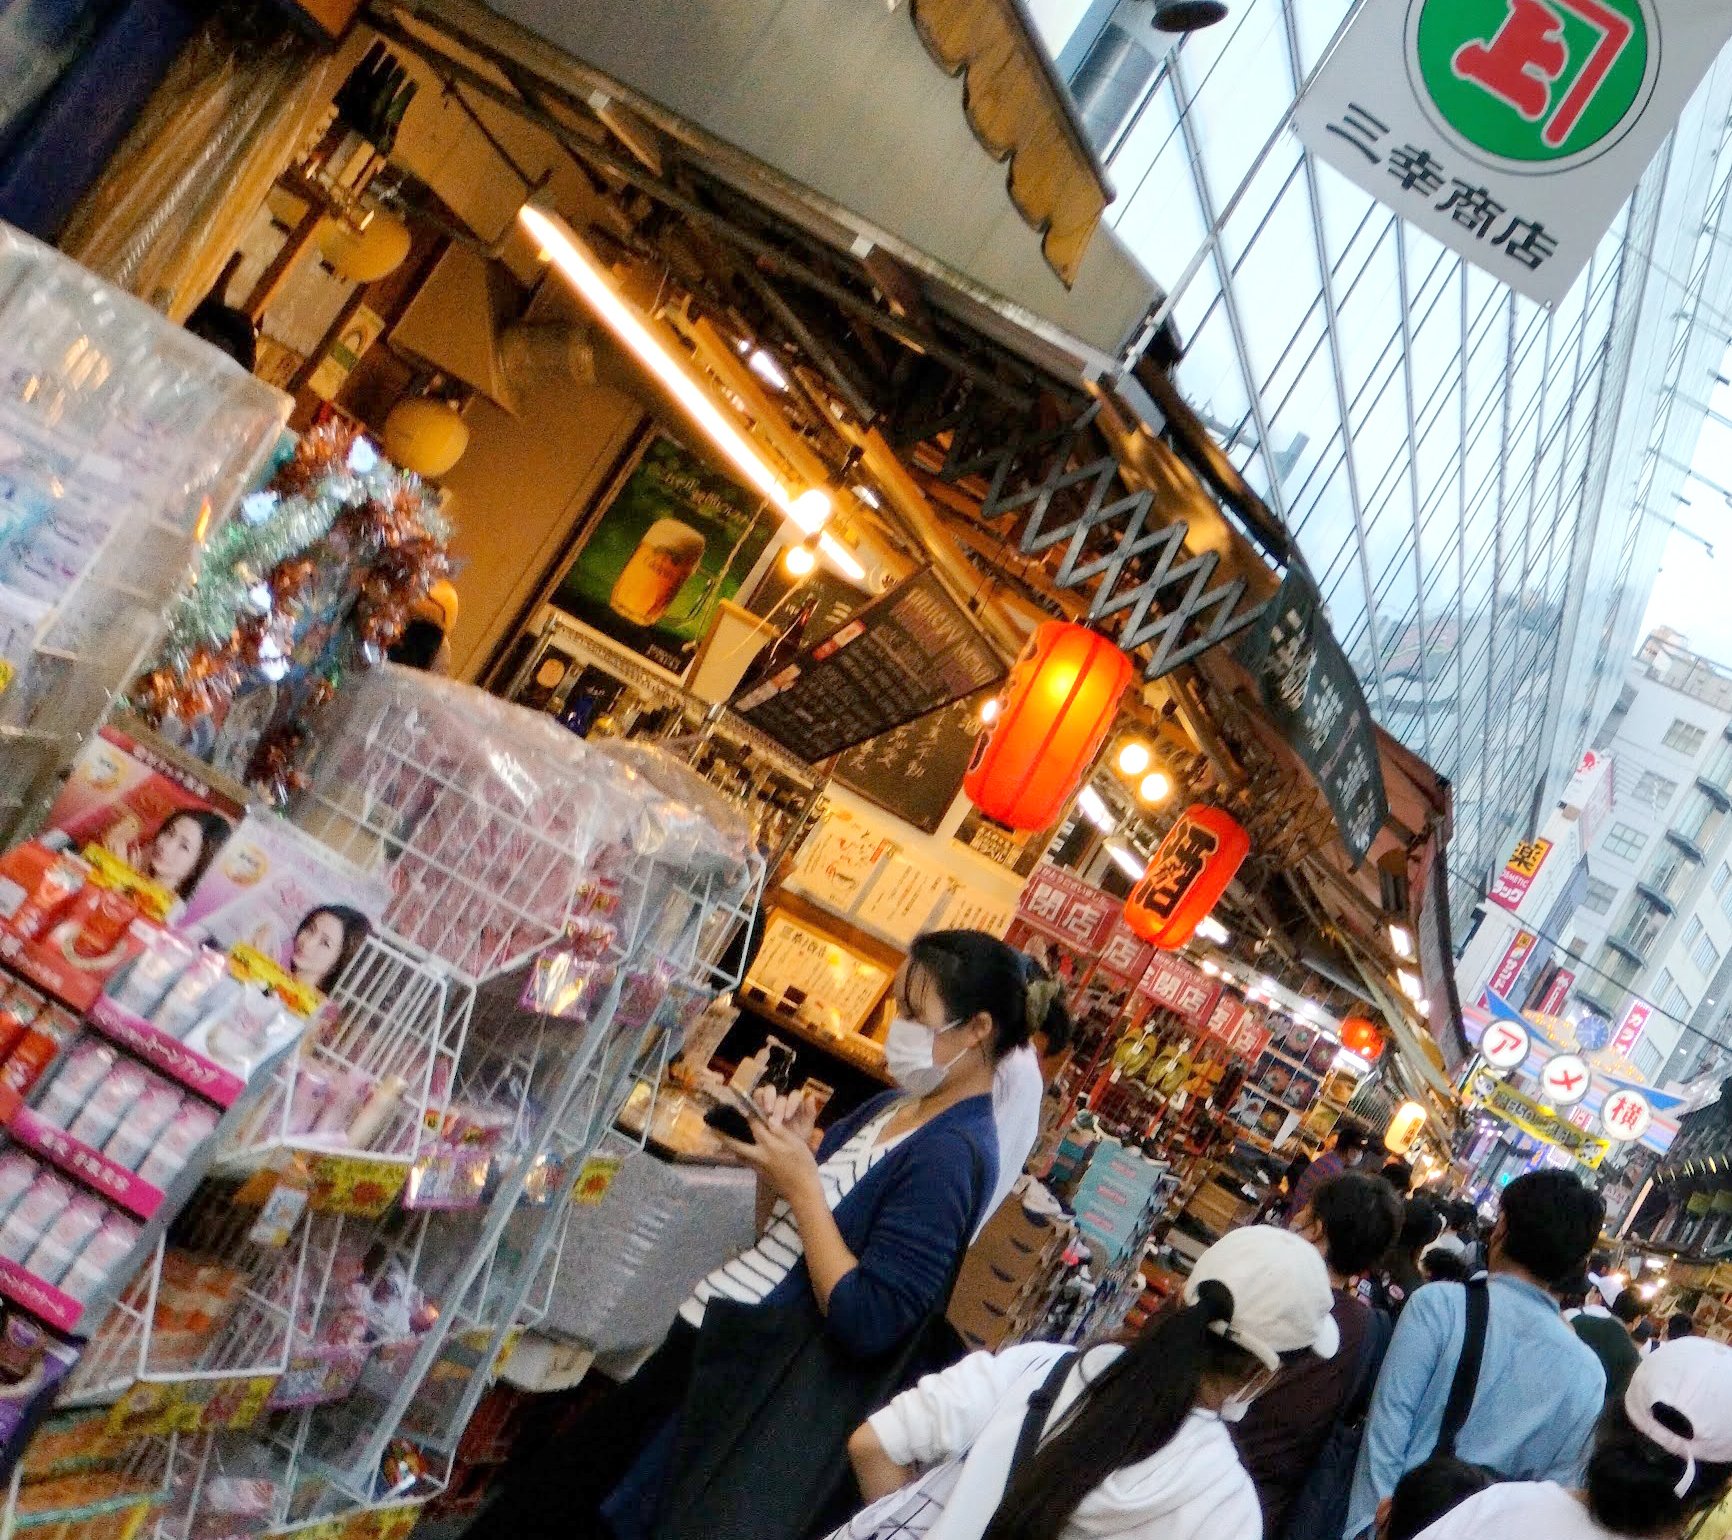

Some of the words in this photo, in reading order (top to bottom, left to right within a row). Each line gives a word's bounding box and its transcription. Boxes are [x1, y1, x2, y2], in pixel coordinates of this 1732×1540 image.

[1326, 102, 1559, 270] 三幸商店
[1491, 1027, 1643, 1131] アメ横
